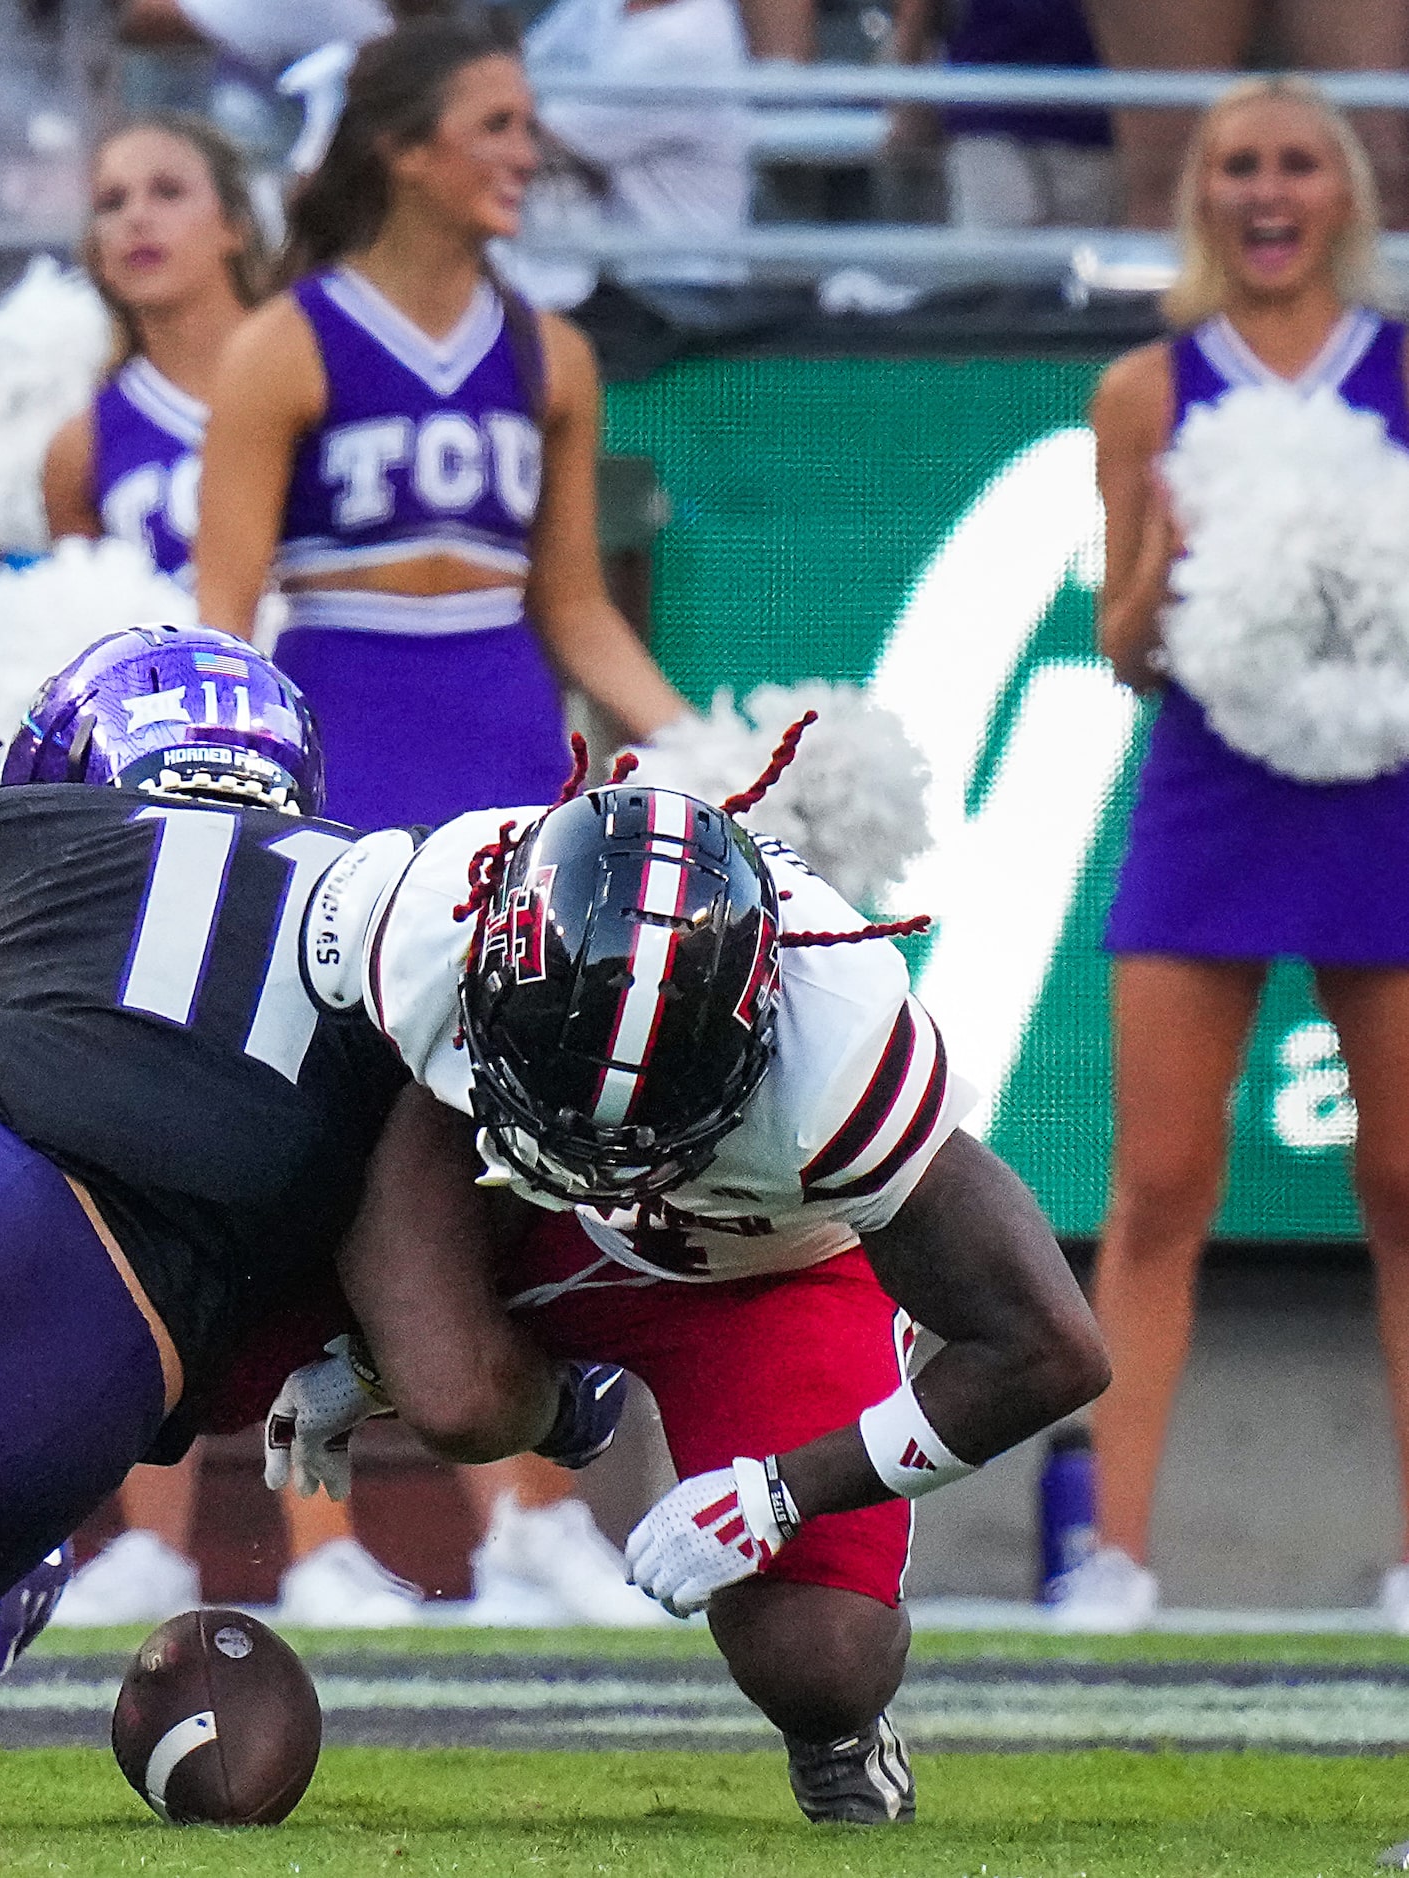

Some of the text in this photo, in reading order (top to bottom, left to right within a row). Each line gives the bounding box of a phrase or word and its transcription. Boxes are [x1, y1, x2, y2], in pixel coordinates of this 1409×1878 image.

[321, 410, 542, 528] TCU
[200, 680, 252, 731] 11
[163, 747, 233, 767] HORNED
[118, 804, 354, 1085] 11
